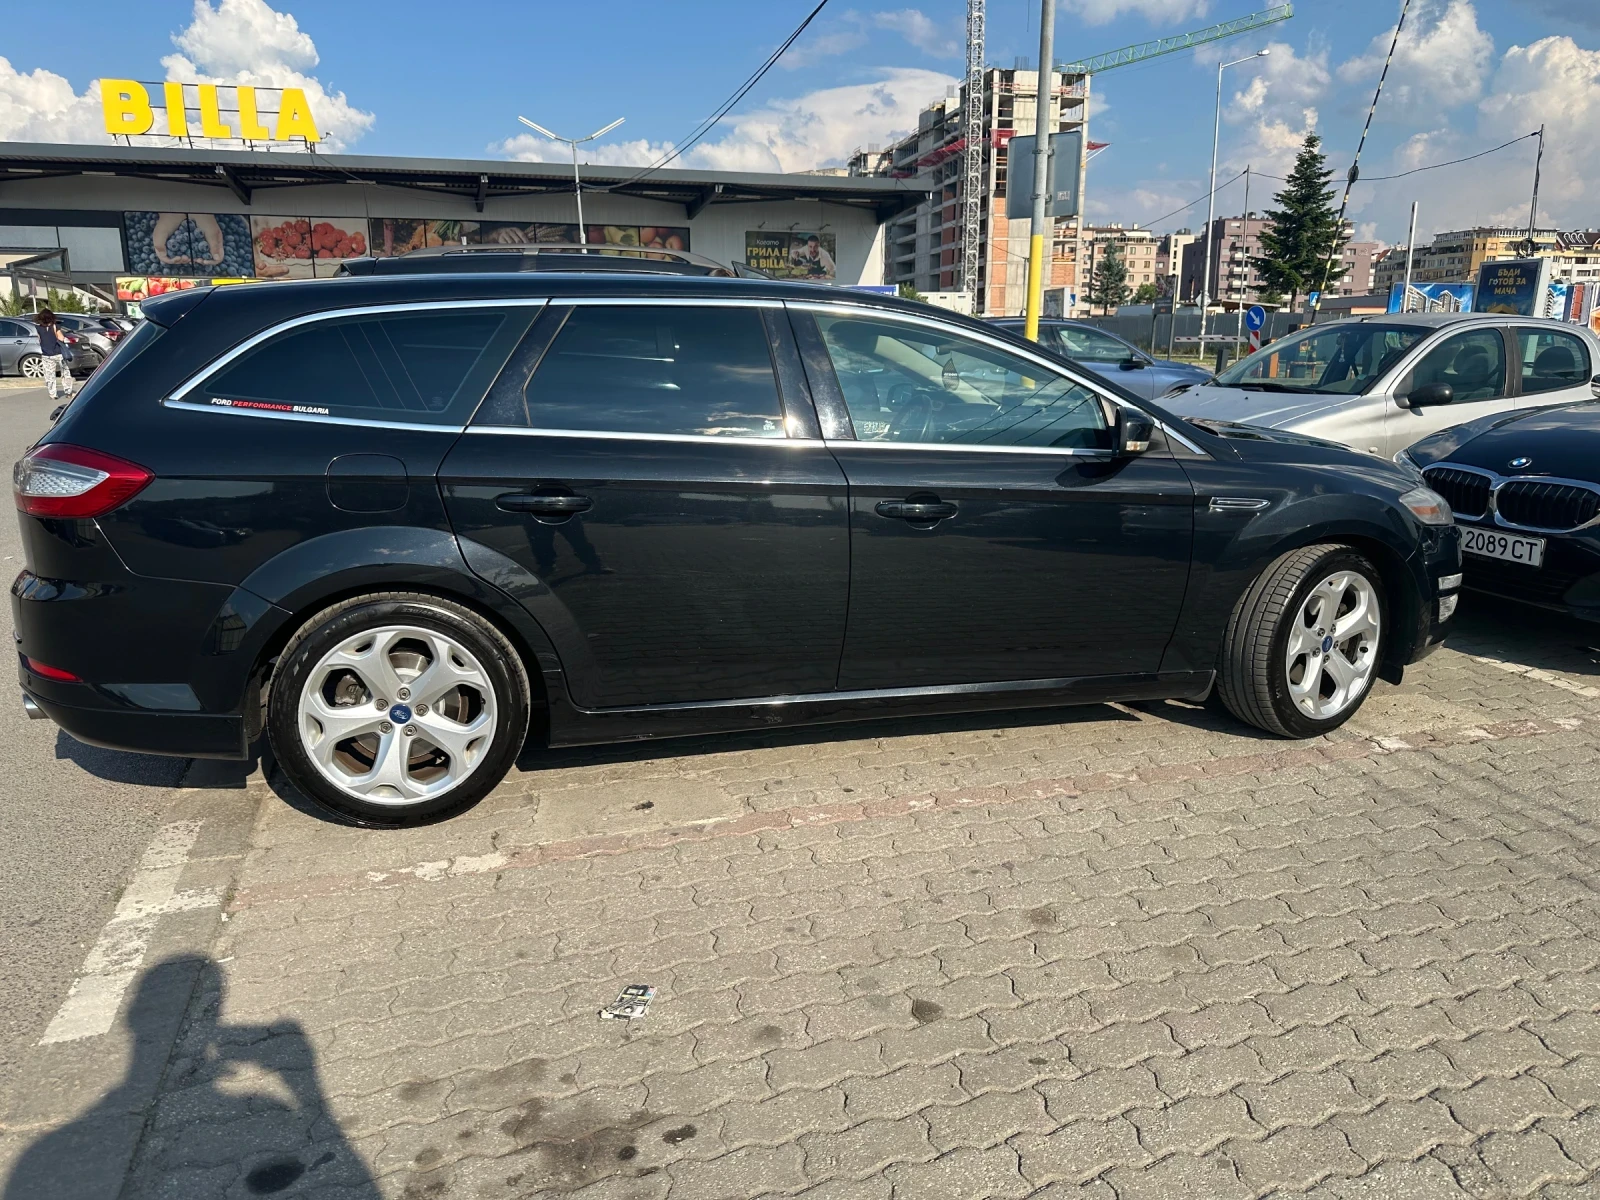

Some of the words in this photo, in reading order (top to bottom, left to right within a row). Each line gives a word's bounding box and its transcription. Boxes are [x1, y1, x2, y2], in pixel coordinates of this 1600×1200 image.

[99, 78, 321, 142] BILLA
[747, 247, 780, 256] ГРИЛА
[782, 248, 788, 257] Е
[760, 259, 785, 269] BILLA
[1498, 268, 1520, 277] БЪДИ
[211, 398, 232, 406] FORD
[232, 401, 292, 410] PERFORMANCE
[292, 405, 329, 415] BULGARIA
[1464, 530, 1508, 556] 2089
[1511, 539, 1538, 562] CT
